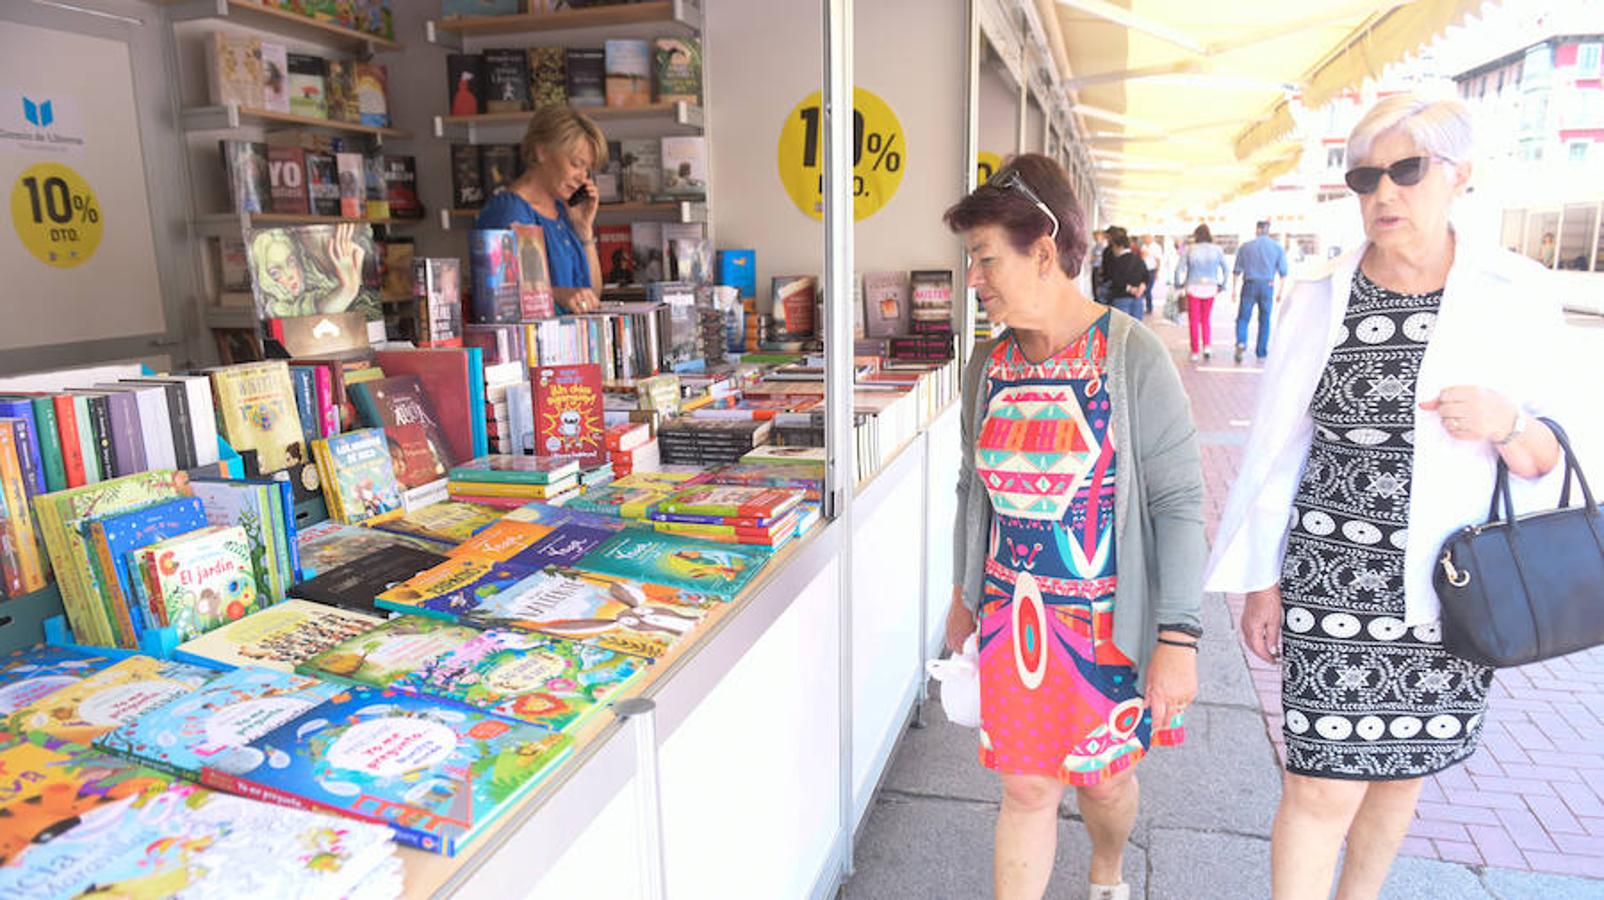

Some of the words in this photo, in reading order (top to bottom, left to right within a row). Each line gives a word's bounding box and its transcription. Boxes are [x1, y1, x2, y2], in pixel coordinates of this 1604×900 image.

[269, 160, 301, 188] YO
[22, 176, 99, 224] 10%
[180, 568, 193, 586] El
[197, 557, 235, 586] jardín
